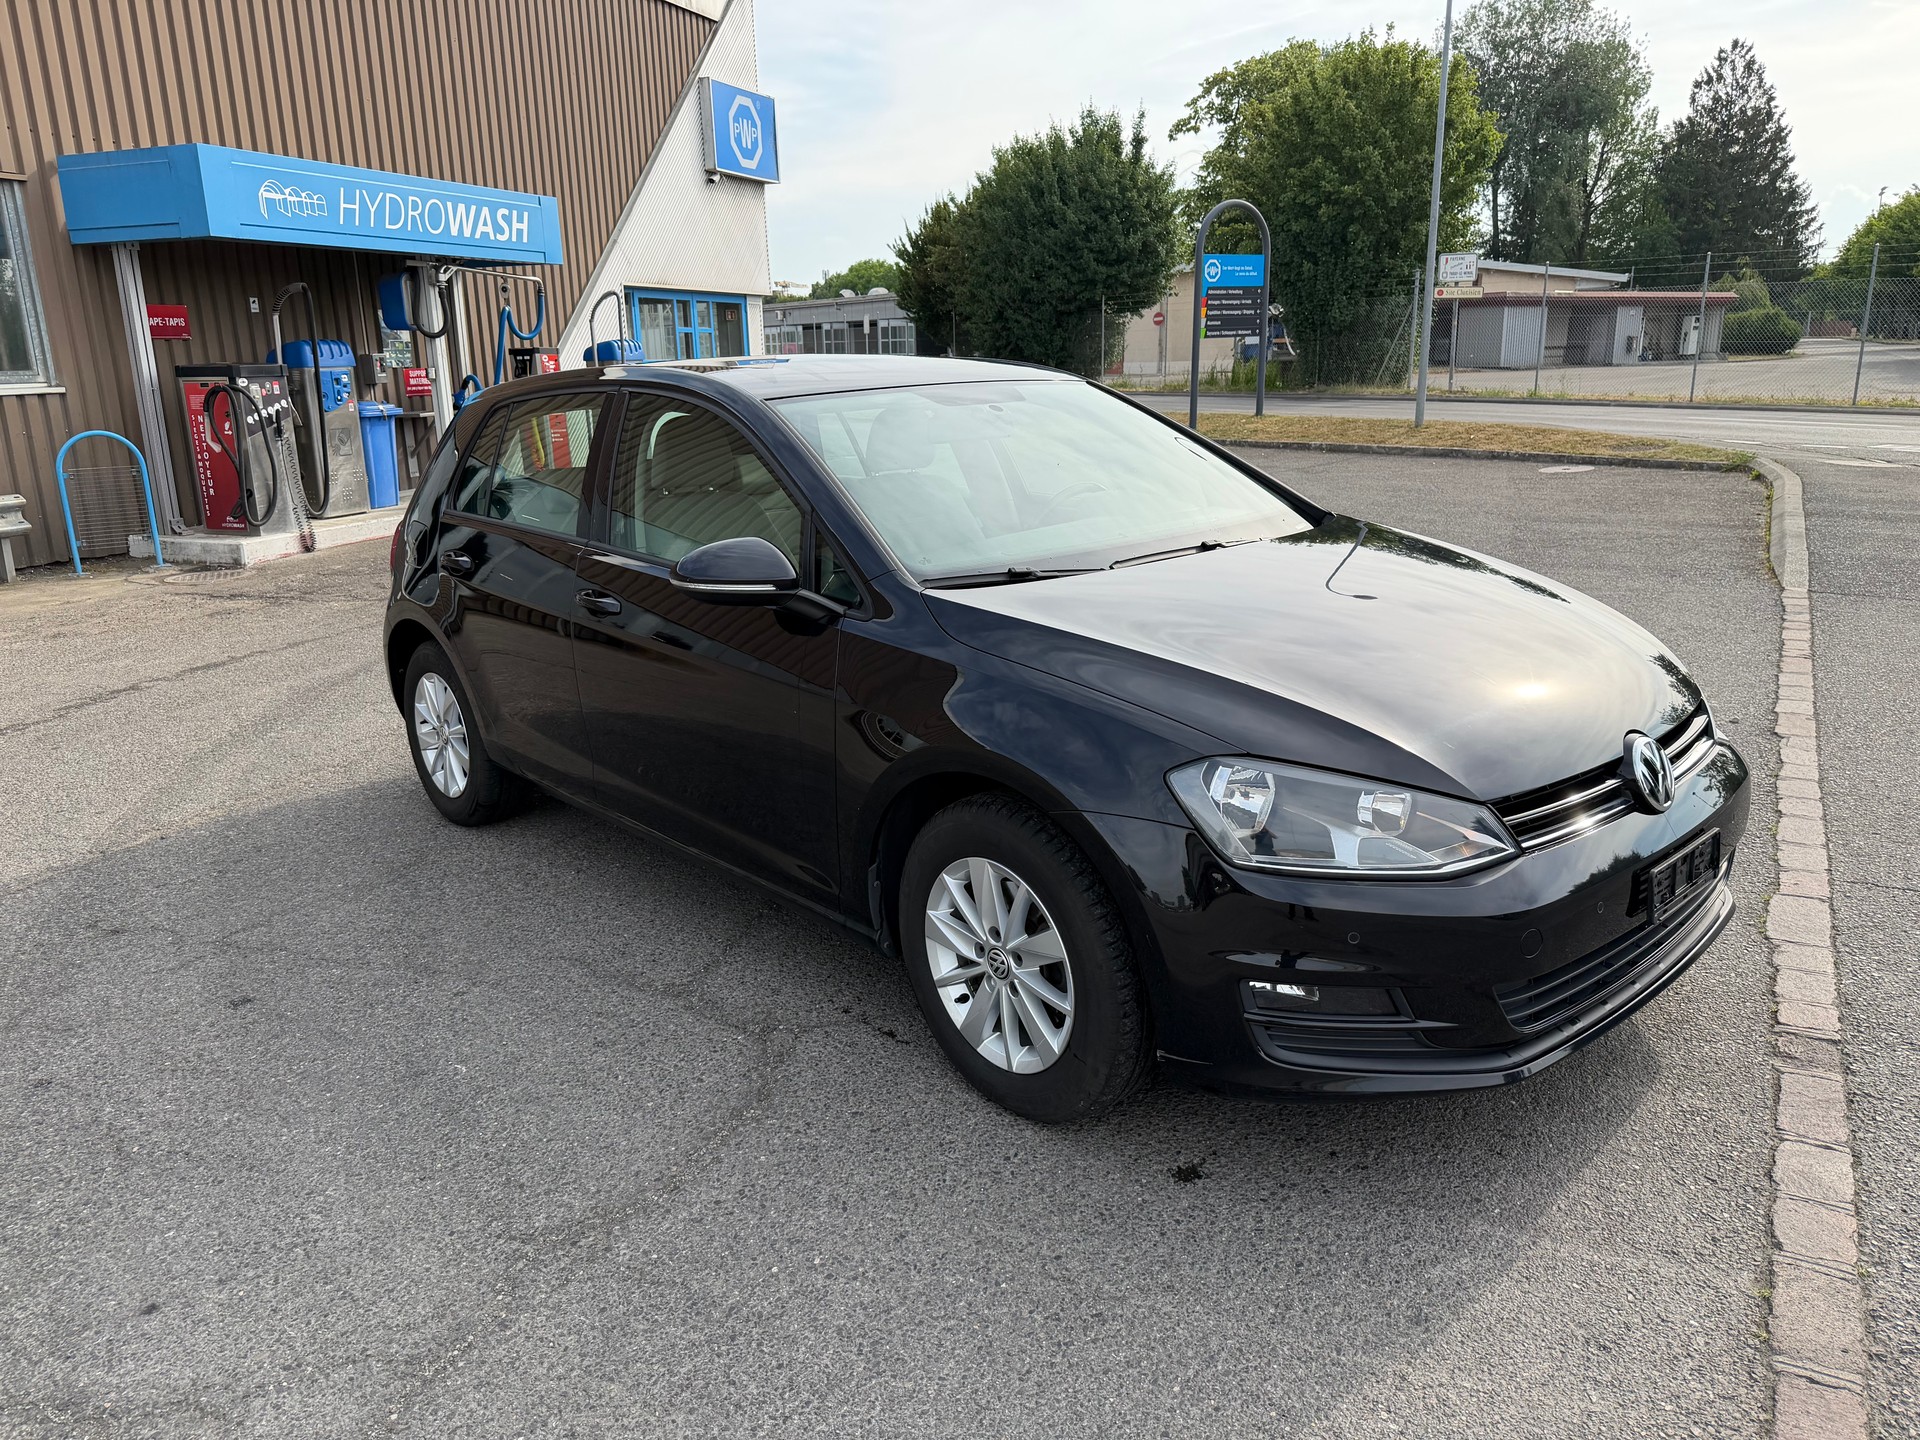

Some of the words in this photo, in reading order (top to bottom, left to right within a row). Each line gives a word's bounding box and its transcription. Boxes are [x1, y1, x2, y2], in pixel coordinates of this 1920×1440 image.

[734, 117, 758, 150] PWP
[339, 187, 529, 243] HYDROWASH
[149, 317, 186, 327] APE-TAPIS
[197, 415, 215, 496] NETTOYEUR
[198, 461, 210, 517] MOQUETTES
